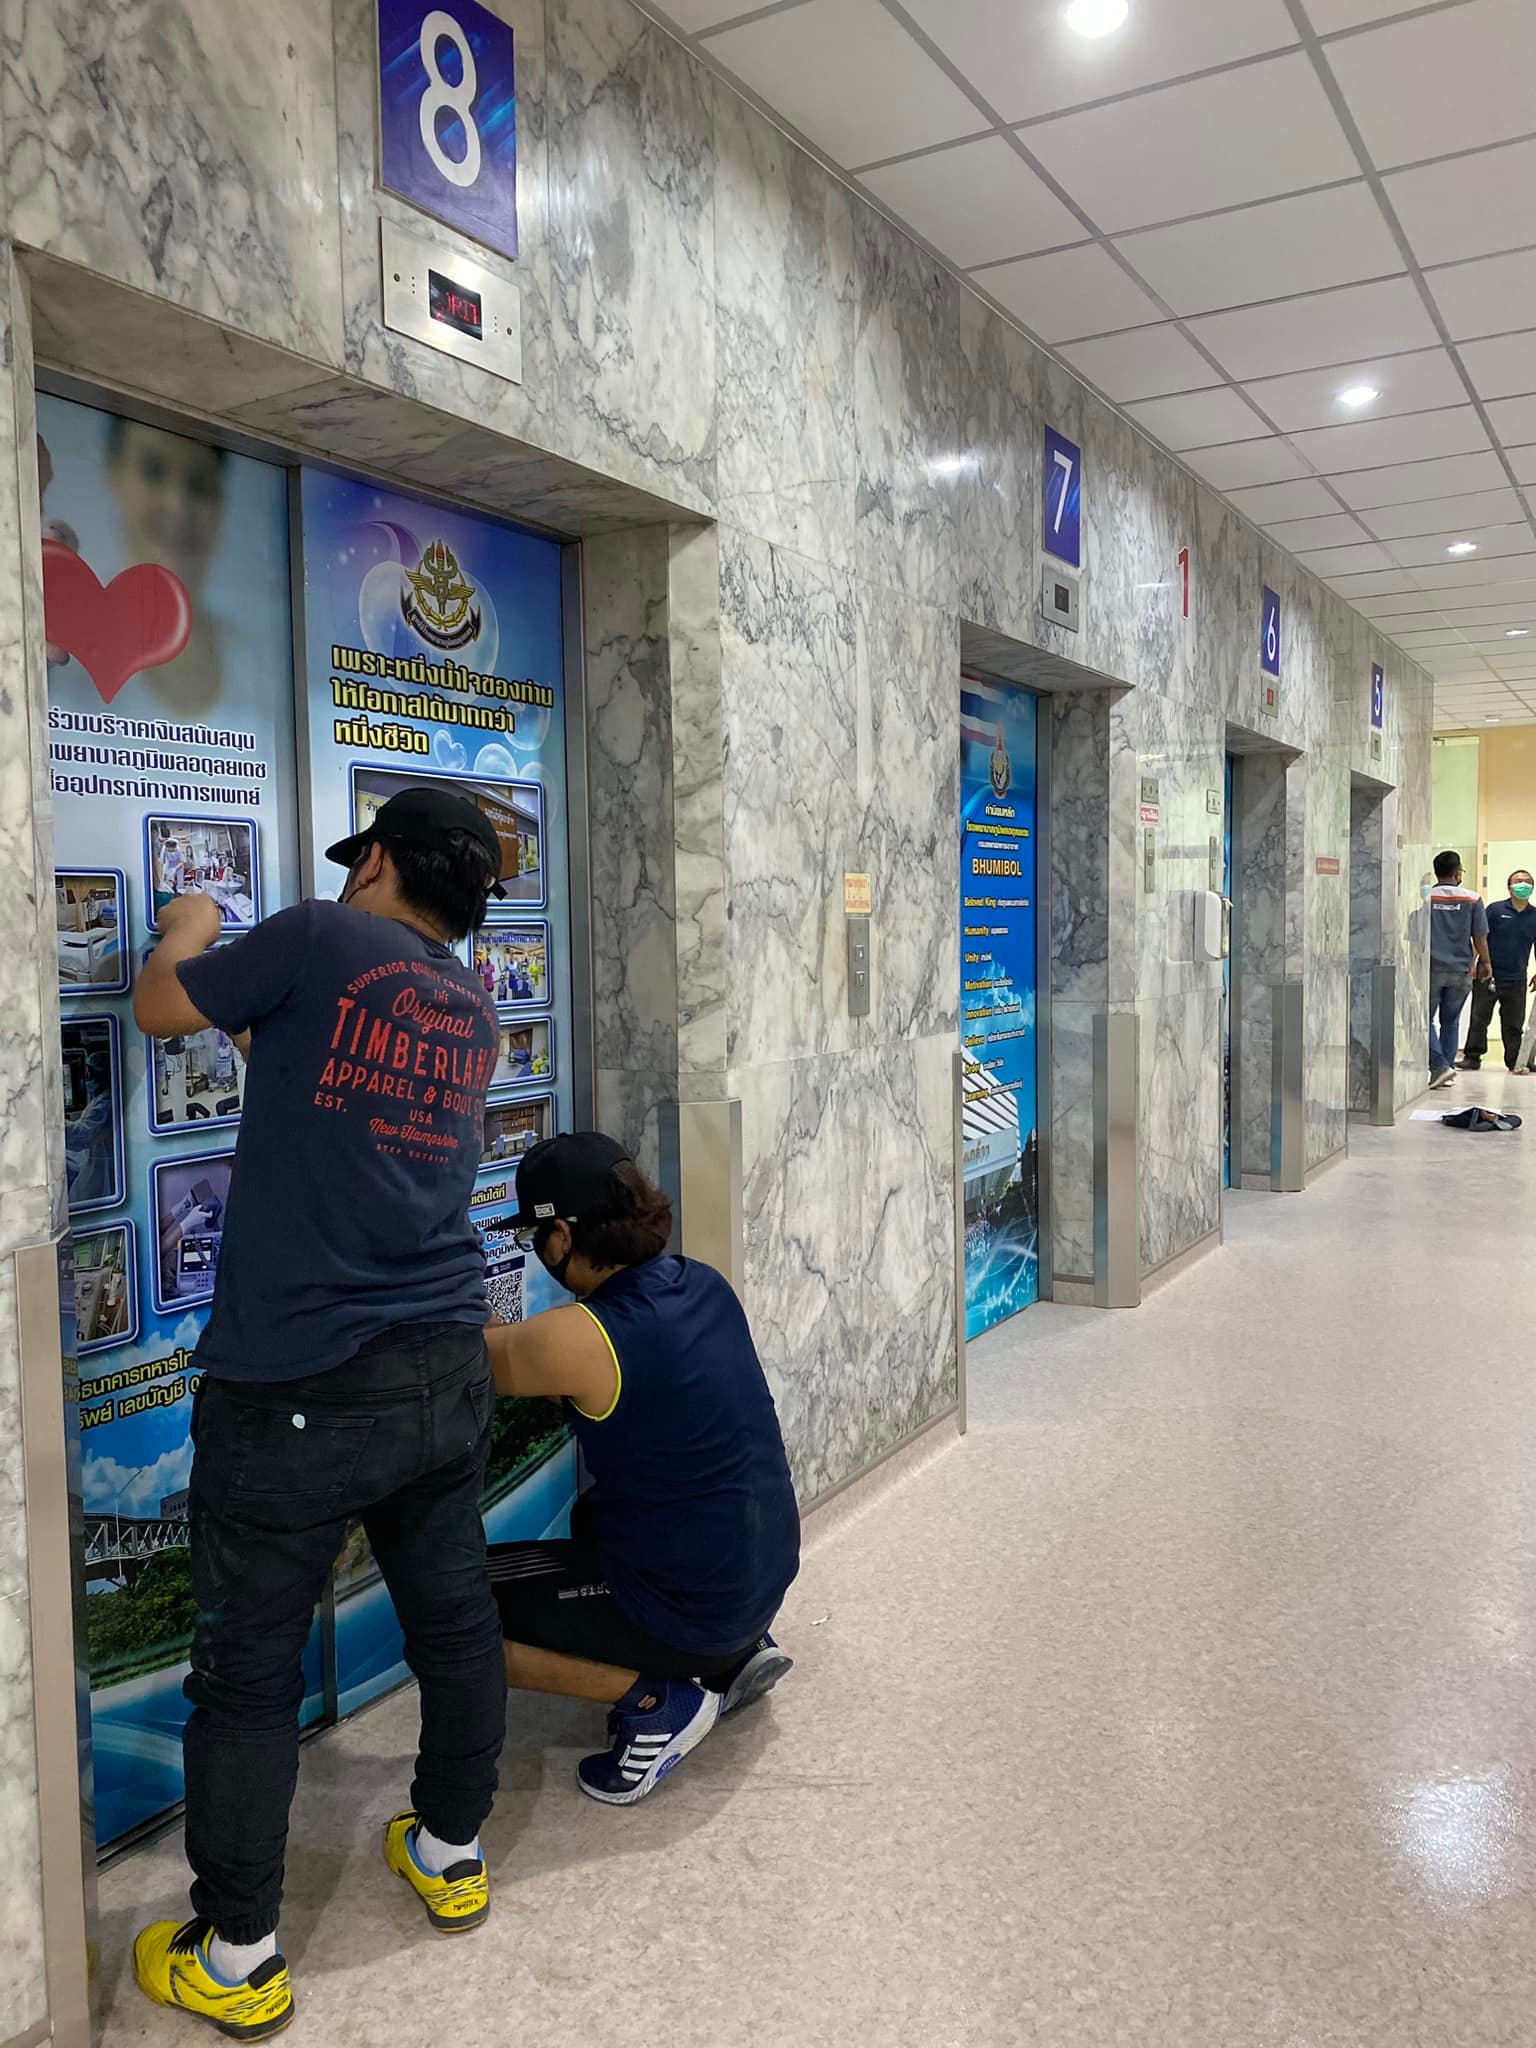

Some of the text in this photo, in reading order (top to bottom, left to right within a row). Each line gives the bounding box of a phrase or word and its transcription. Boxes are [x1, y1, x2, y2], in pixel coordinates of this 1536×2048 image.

[420, 10, 481, 187] 8
[1054, 450, 1073, 534] 7
[1177, 546, 1189, 620] 1
[1266, 606, 1277, 662] 6
[333, 647, 553, 706] เพราะหนึ่งน้ำใจของท่าน
[1373, 674, 1381, 716] 5
[331, 679, 515, 732] ให้โอกาสได้มากกว่า
[48, 707, 255, 751] ร่วมบริจาคเงินสนับสนุน
[335, 716, 428, 754] หนึ่งชีวิต
[972, 857, 1023, 877] BHUMIBOL
[347, 961, 408, 995] SUPERIOR
[392, 987, 474, 1039] Original
[314, 1093, 347, 1112] EST.
[320, 1058, 415, 1101] APPAREL
[424, 1086, 437, 1104] &
[369, 1118, 399, 1135] New
[400, 1124, 459, 1149] Hampshire
[409, 1109, 433, 1125] USA
[120, 1380, 184, 1416] เลขบัญชี
